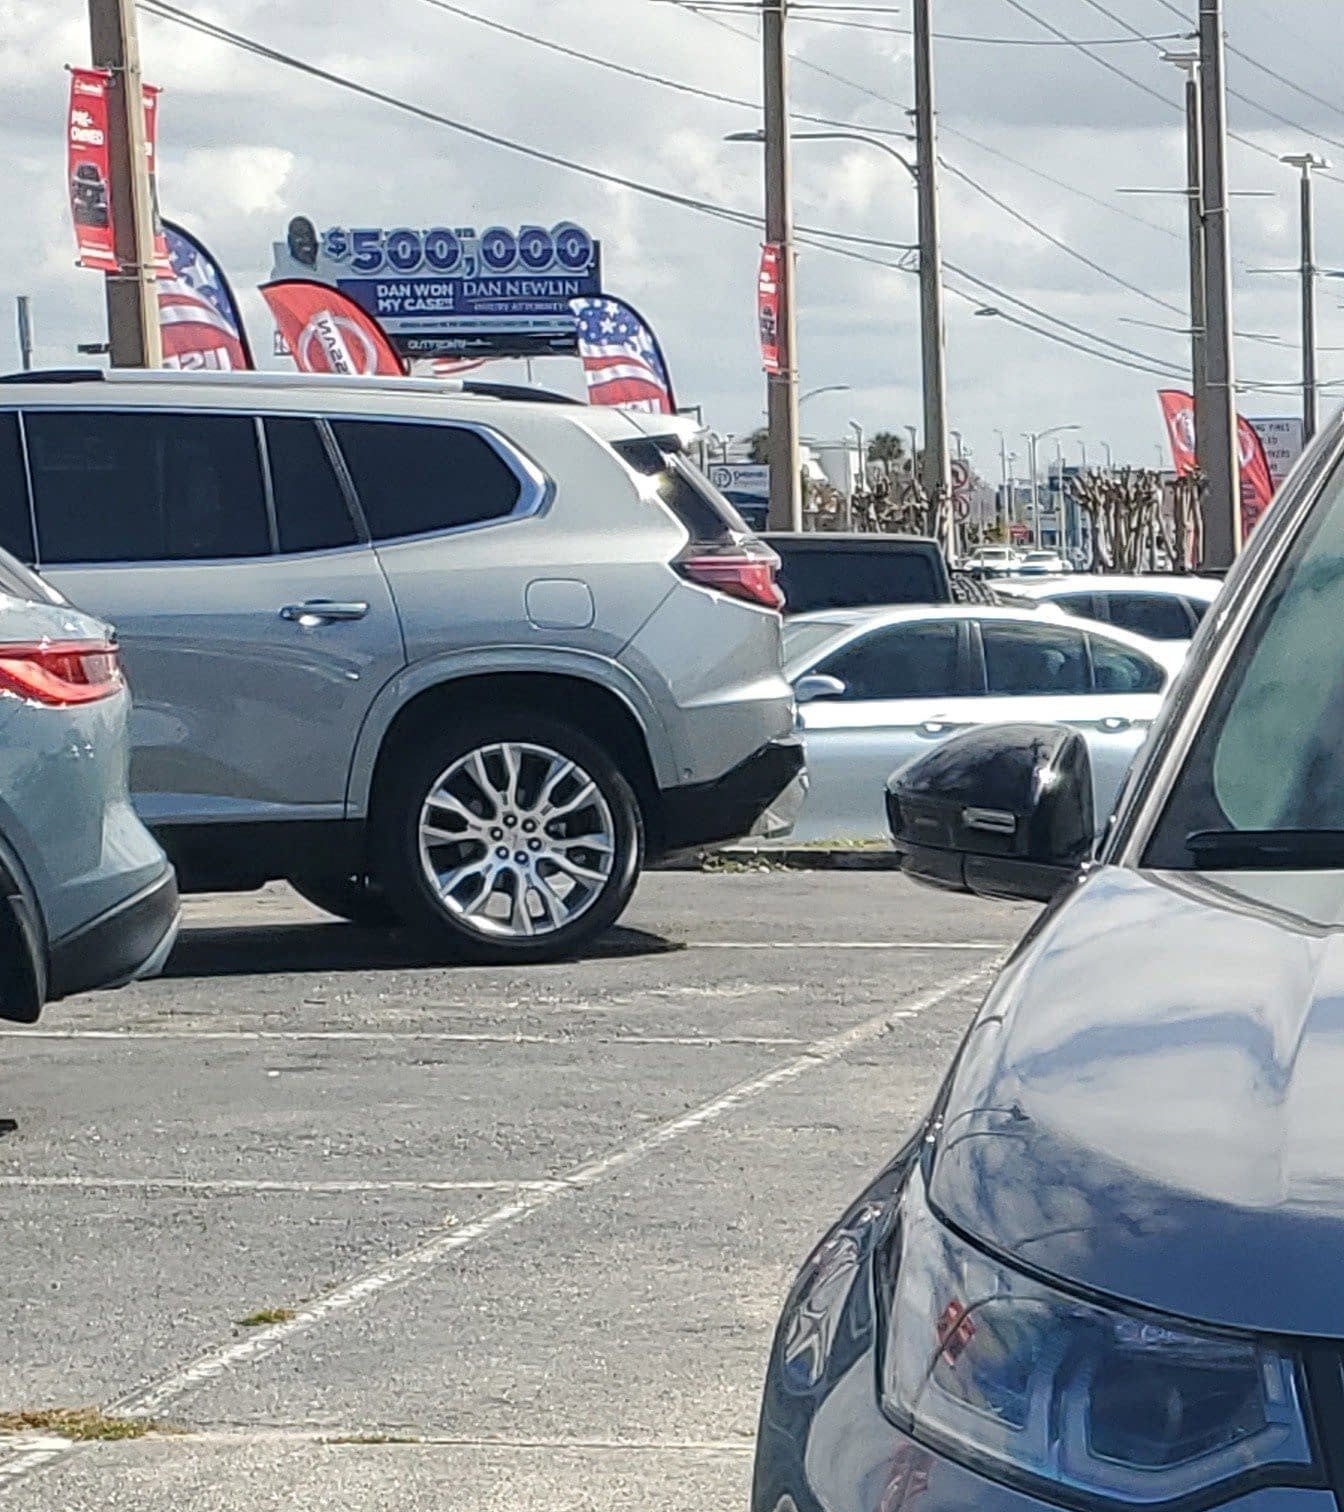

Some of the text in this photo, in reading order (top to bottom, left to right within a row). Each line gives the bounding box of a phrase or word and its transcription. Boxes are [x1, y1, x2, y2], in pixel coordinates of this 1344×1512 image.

[325, 222, 594, 279] $500,000
[377, 283, 453, 298] DAN WON
[463, 281, 579, 296] DAN NEWLIN
[378, 298, 401, 312] MY
